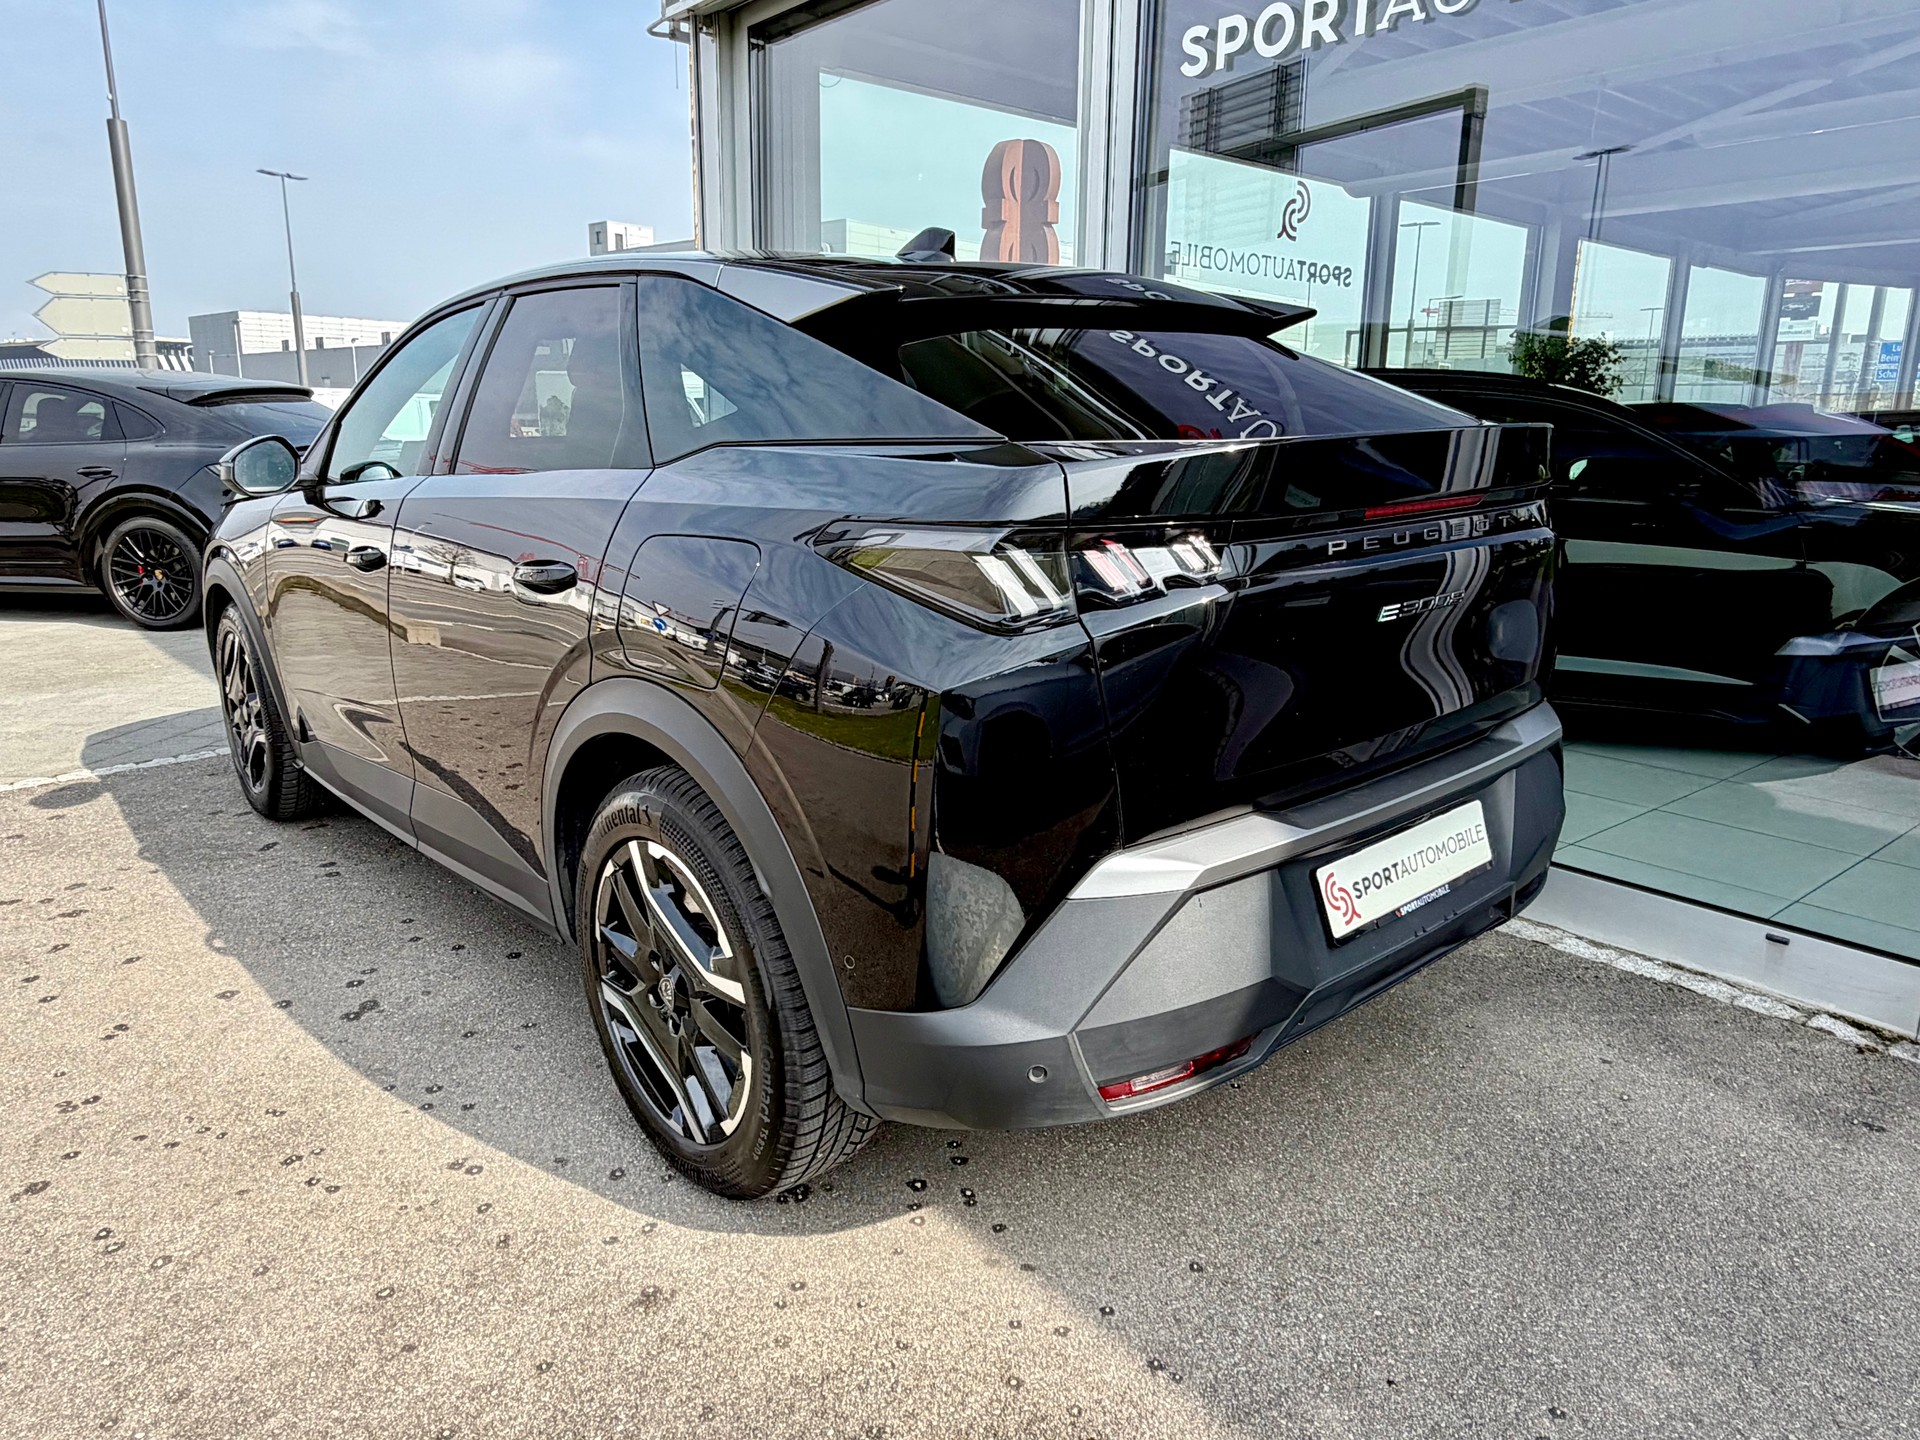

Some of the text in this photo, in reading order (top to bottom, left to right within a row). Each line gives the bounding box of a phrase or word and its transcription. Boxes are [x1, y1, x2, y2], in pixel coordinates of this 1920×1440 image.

[1180, 0, 1472, 77] SPORTA
[1328, 514, 1511, 556] PEUGEOT
[1352, 823, 1485, 900] SPORTAUTOMOBILE
[1400, 883, 1451, 916] SPORTAUTOMOBILE
